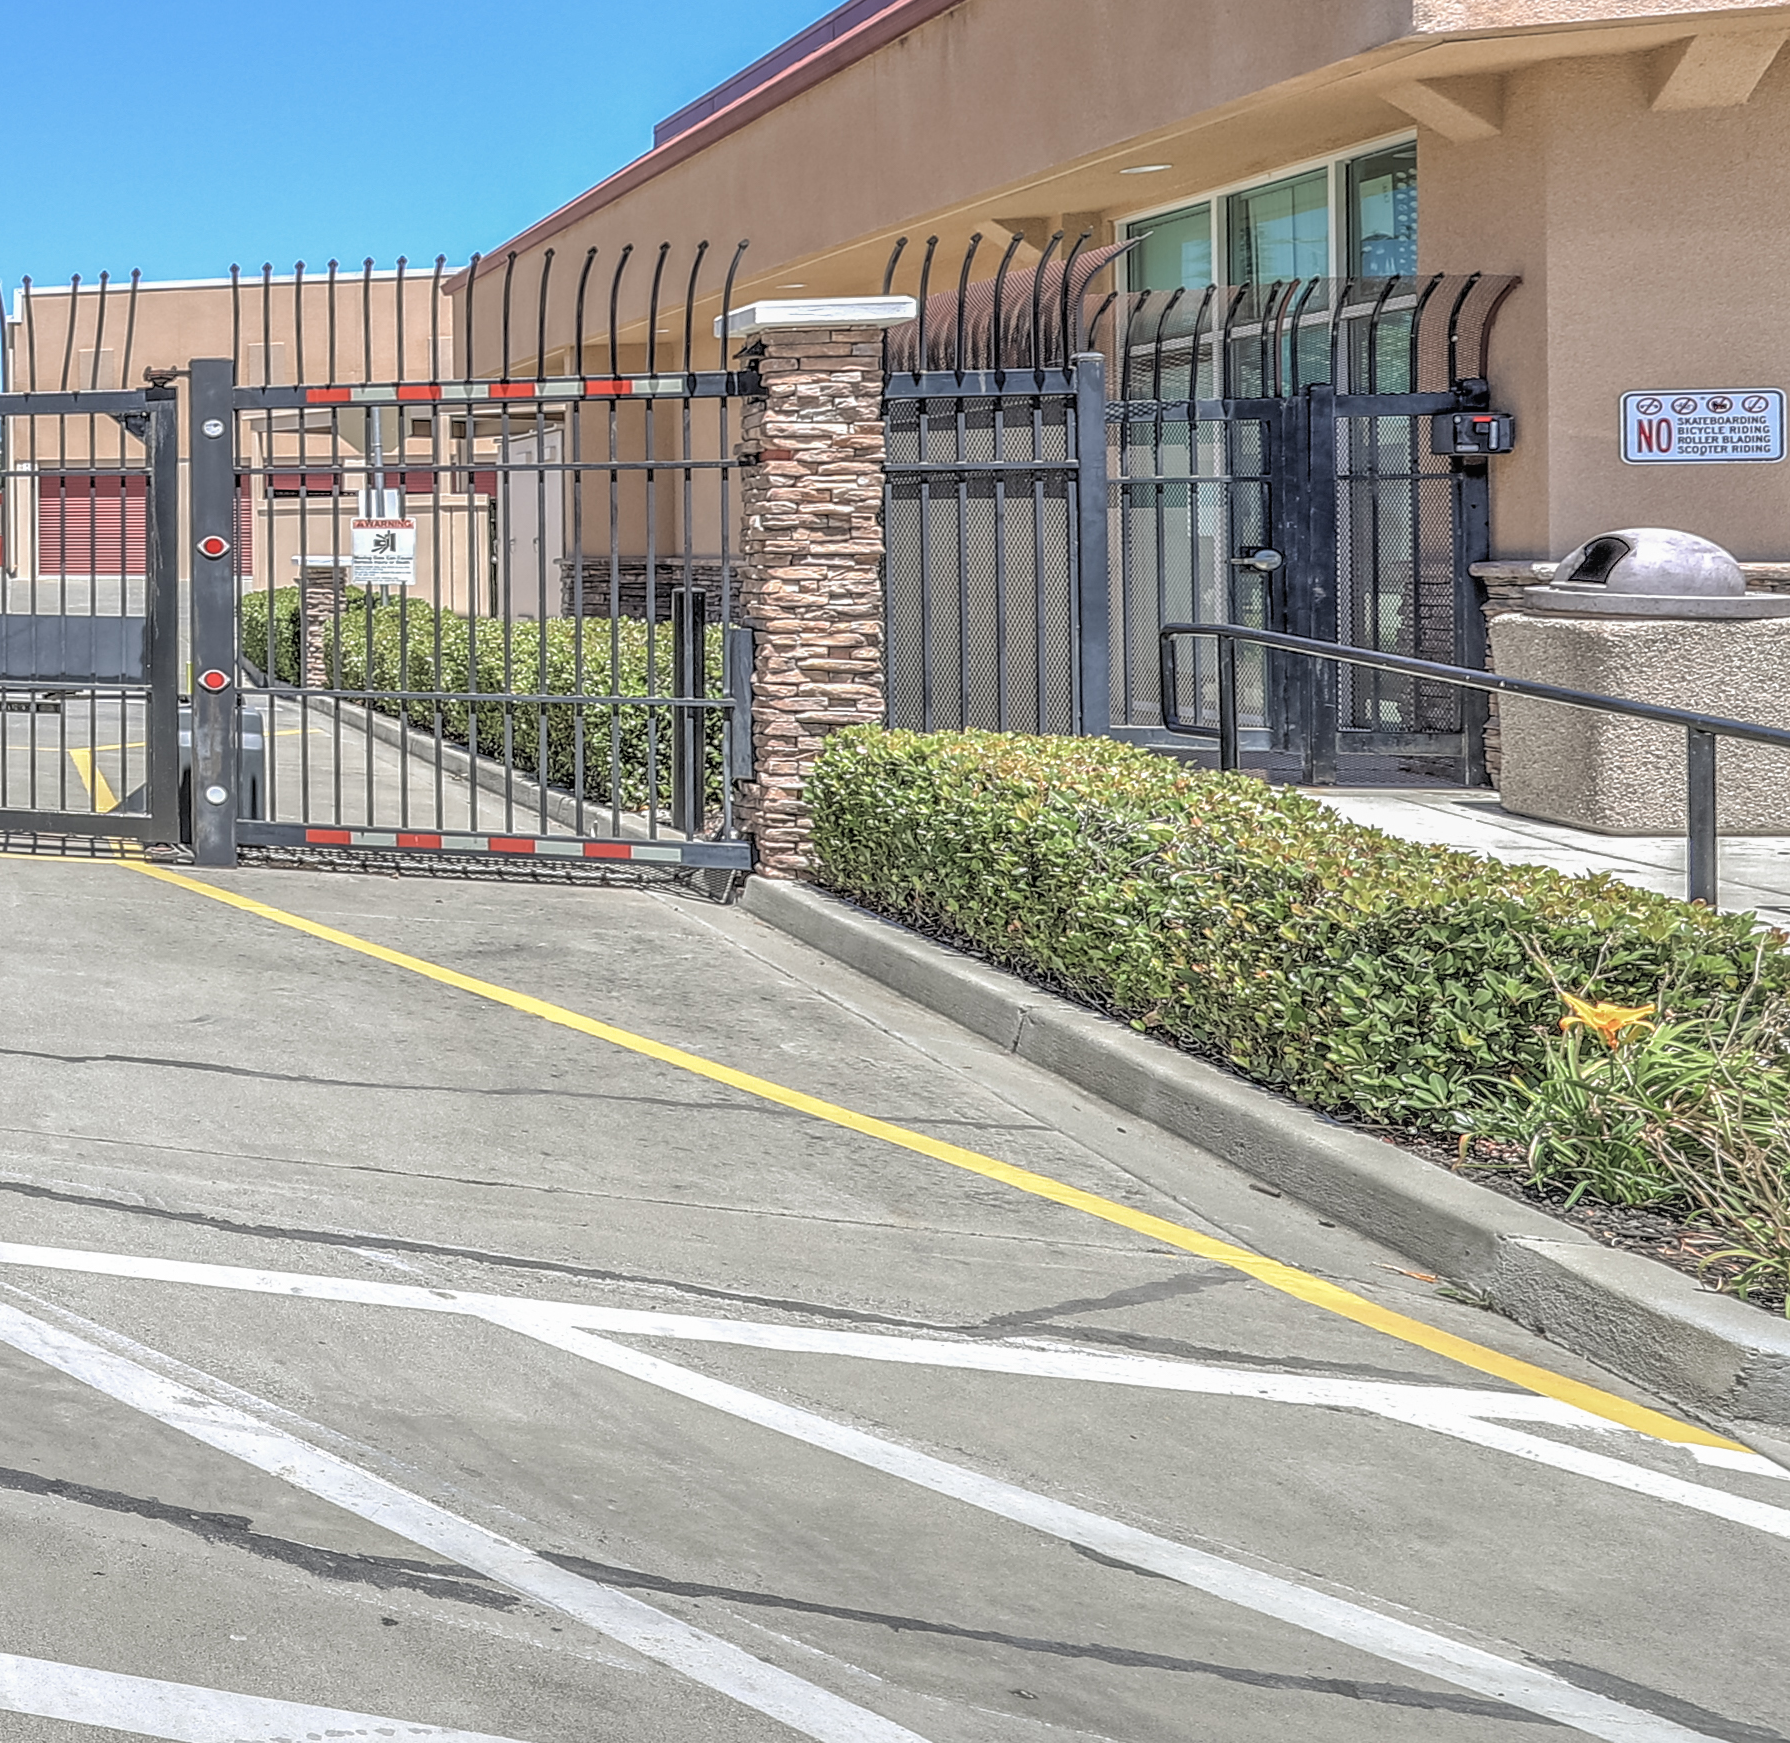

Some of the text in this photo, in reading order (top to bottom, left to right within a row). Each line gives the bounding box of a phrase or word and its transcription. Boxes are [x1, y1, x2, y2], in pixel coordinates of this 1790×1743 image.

[1677, 415, 1767, 426] SKATEBOARDING
[1636, 417, 1672, 454] NO
[1677, 425, 1771, 435] BICYCLE RIDING
[1677, 435, 1771, 444] ROLLER BLADING
[1677, 444, 1771, 455] SCOOTER RIDING
